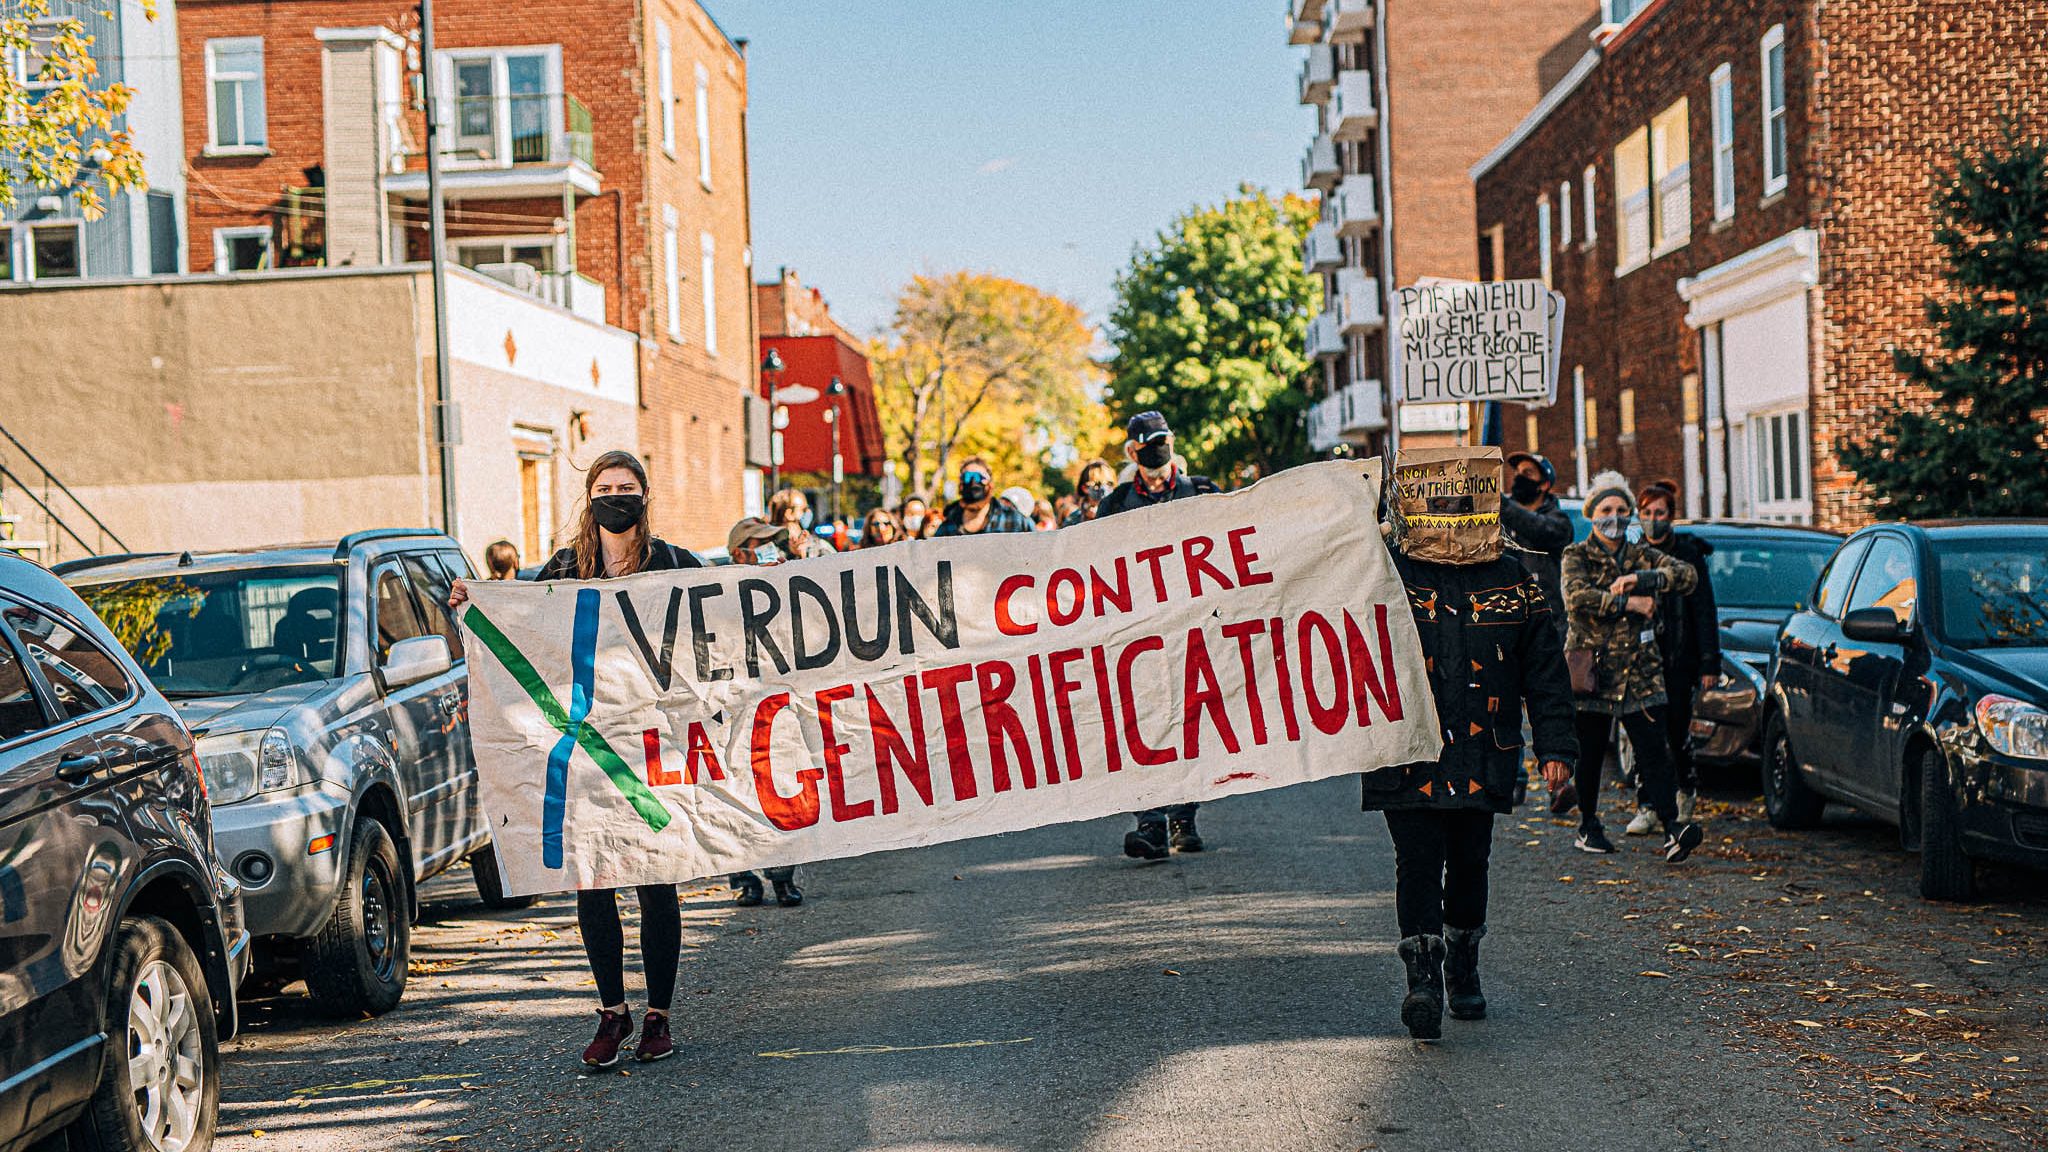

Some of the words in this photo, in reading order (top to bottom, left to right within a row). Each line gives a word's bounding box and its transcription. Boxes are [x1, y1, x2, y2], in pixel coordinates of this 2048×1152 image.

[1401, 314, 1430, 341] QUI
[1494, 310, 1522, 335] LA
[1405, 360, 1440, 400] LA
[1402, 468, 1429, 481] NON
[616, 560, 960, 691] VERDUN
[994, 525, 1273, 636] CONTRE
[642, 721, 725, 787] LA
[751, 604, 1404, 831] GENTRIFICATION
